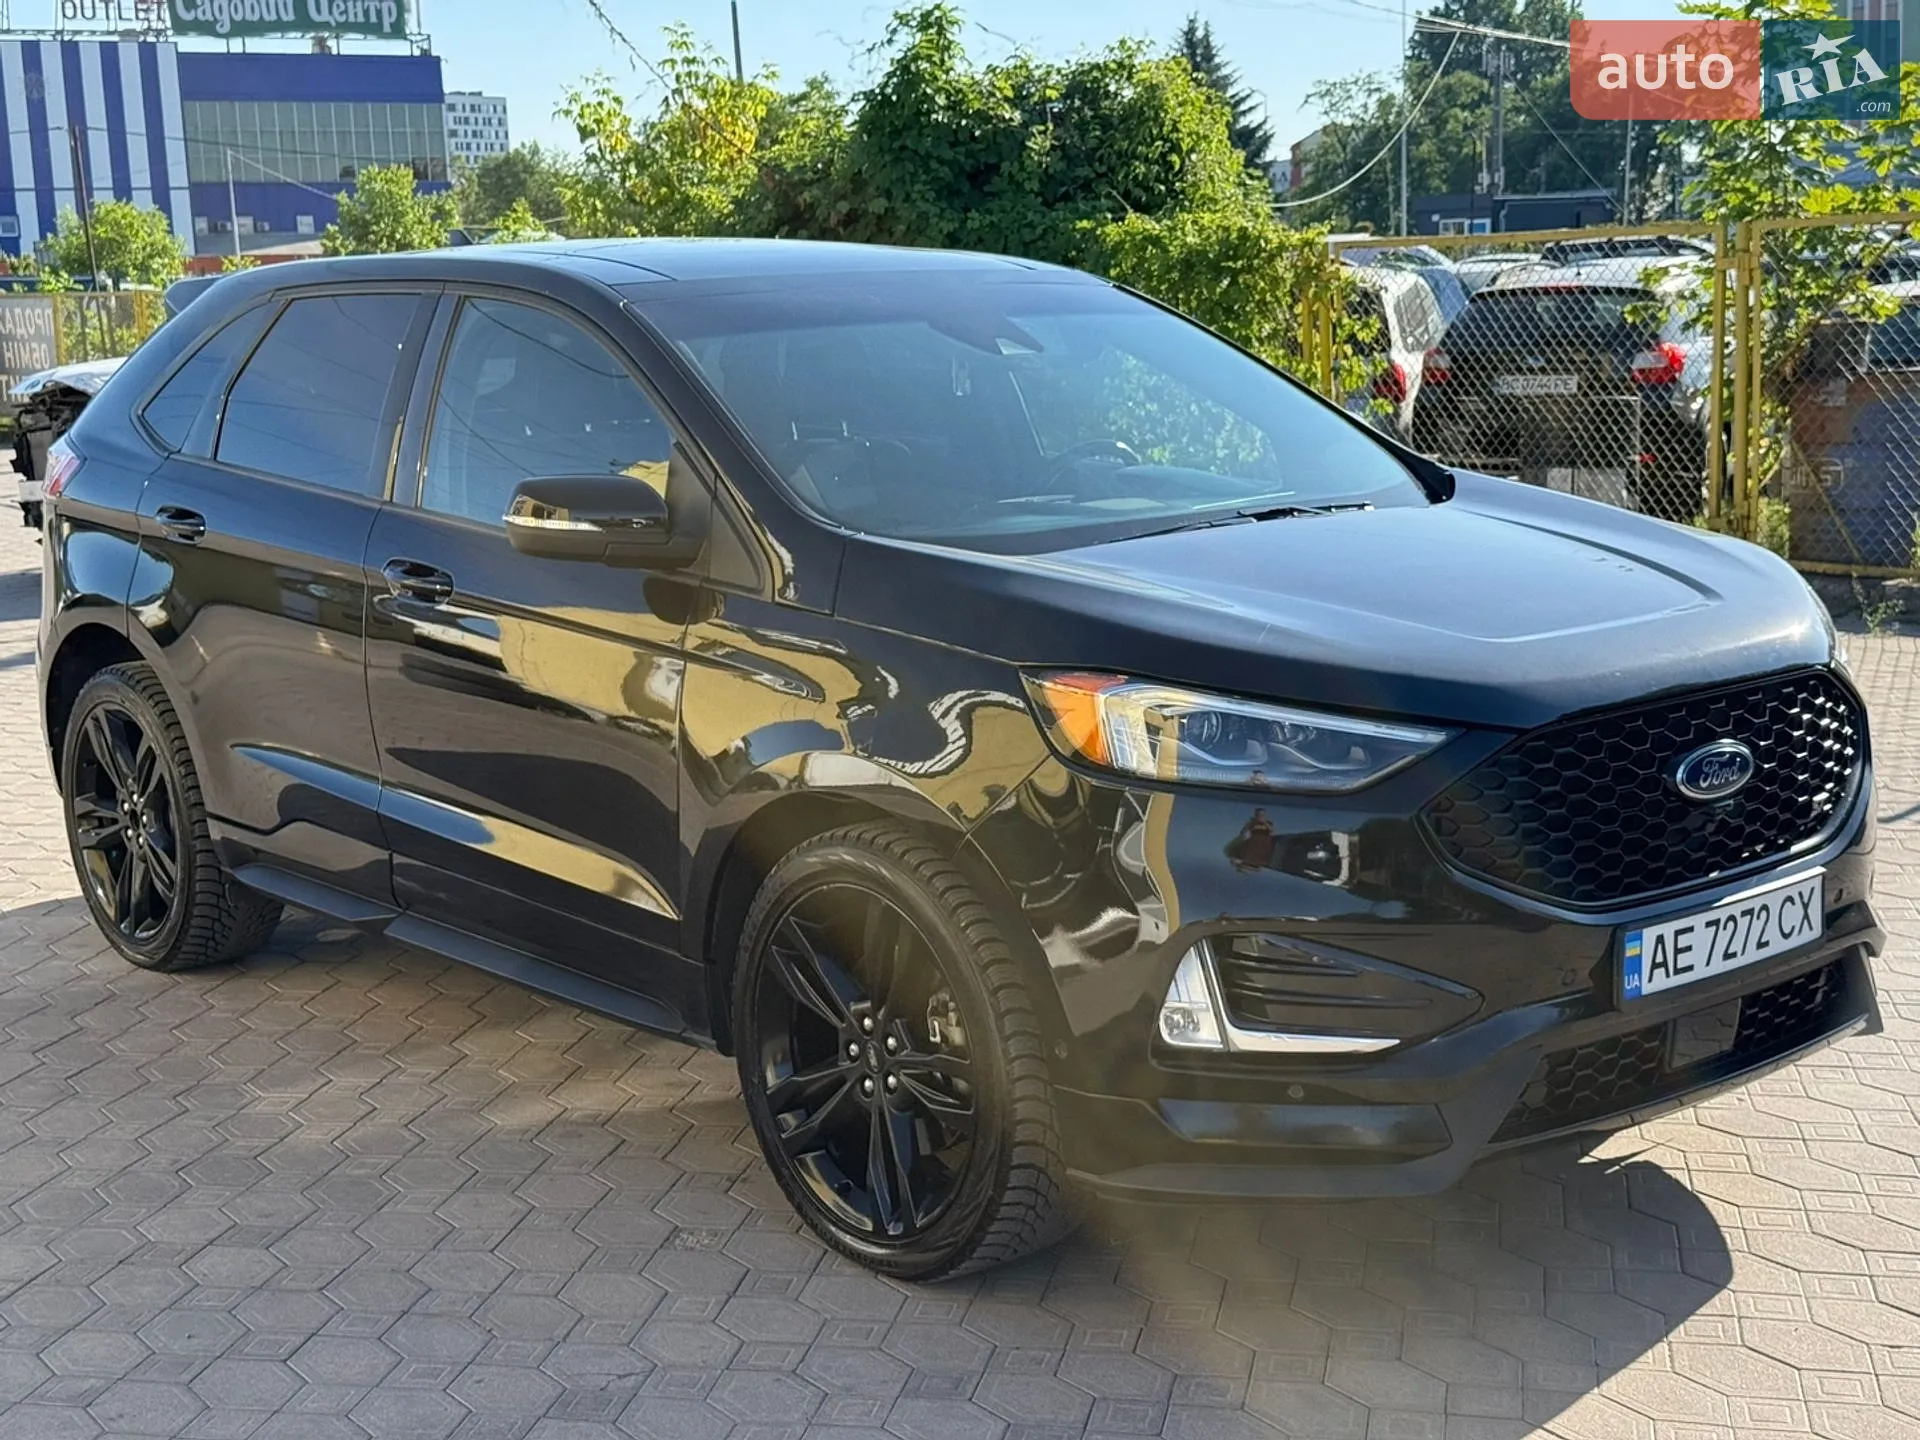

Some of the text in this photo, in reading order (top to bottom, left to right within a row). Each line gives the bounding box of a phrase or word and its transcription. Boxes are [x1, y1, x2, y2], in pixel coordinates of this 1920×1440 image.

[306, 0, 398, 33] Центр
[1699, 753, 1741, 788] Ford
[1647, 886, 1816, 984] AE 7272 CX
[1624, 973, 1641, 990] UA
